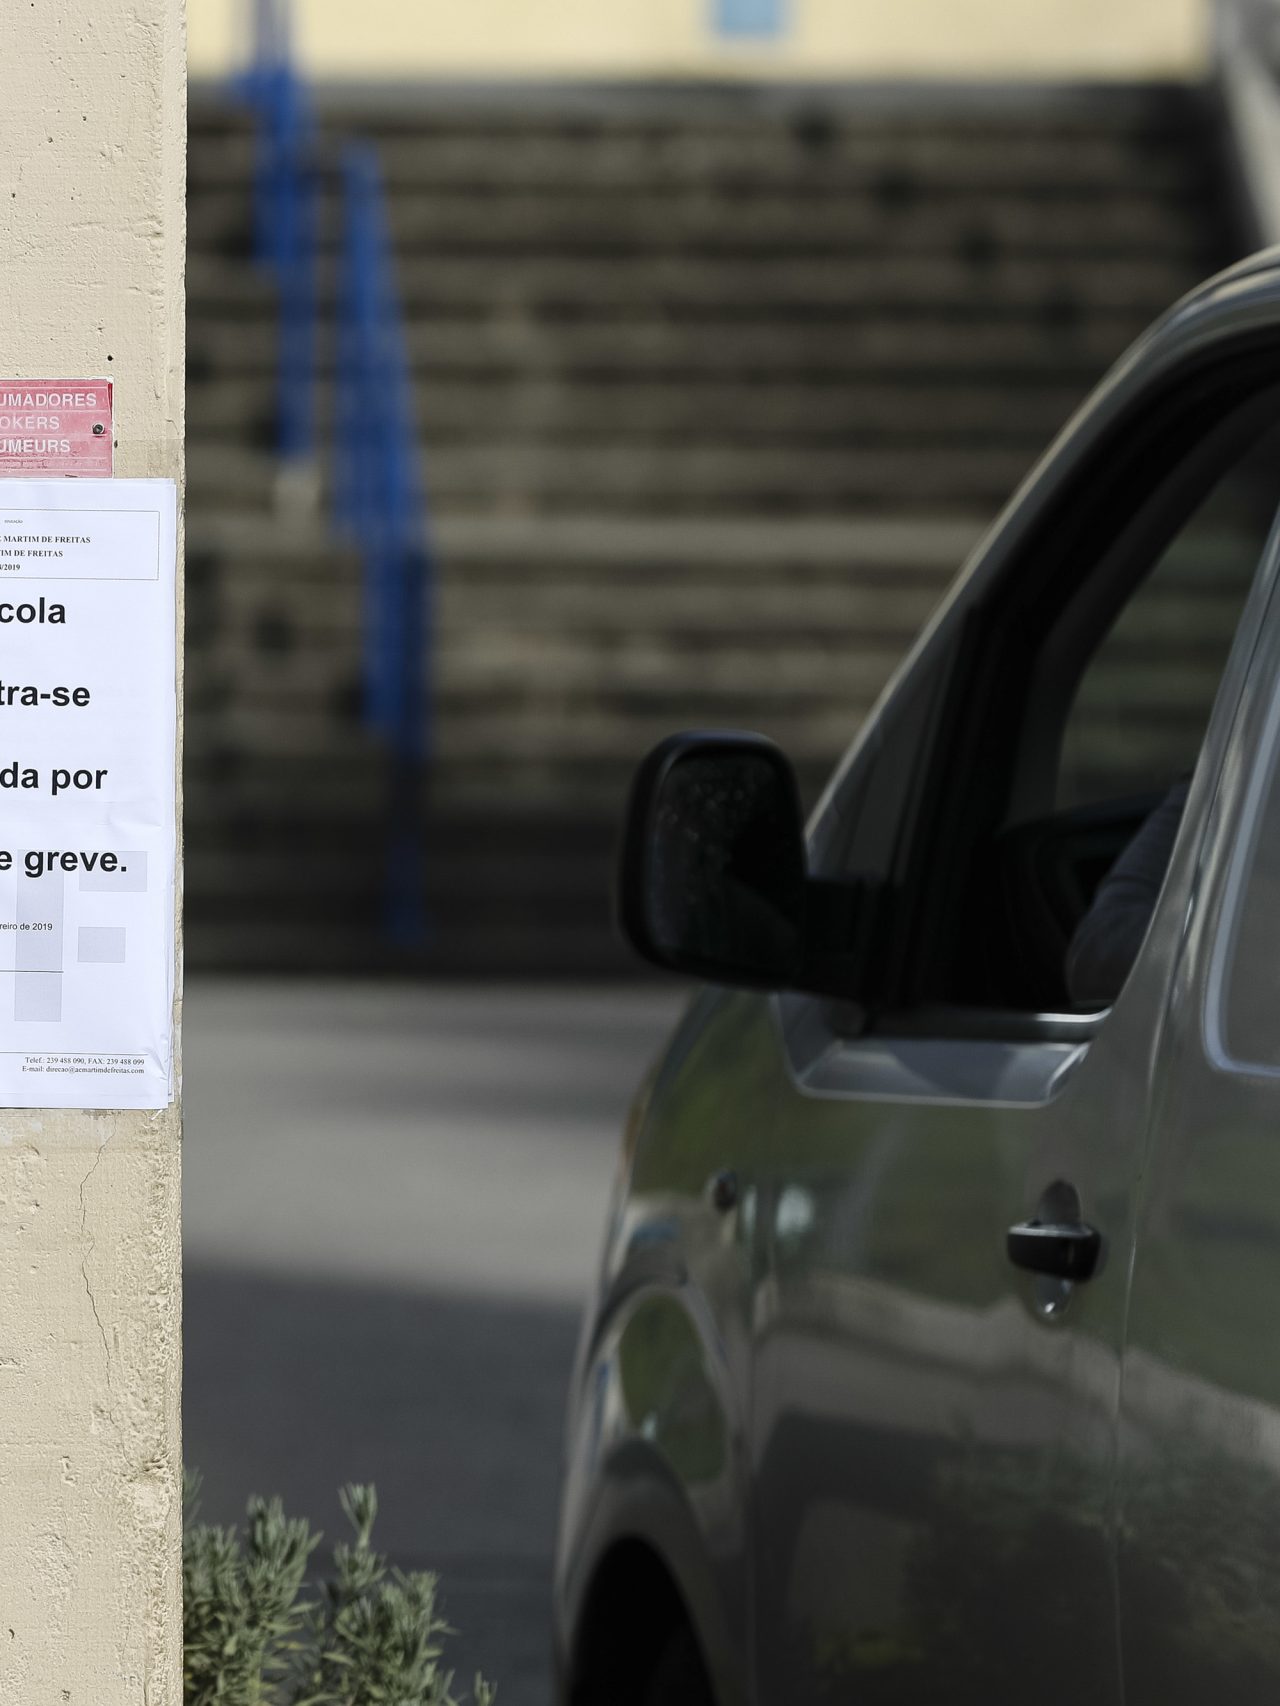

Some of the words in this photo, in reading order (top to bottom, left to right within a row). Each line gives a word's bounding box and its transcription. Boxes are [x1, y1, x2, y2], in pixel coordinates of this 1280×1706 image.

[4, 535, 39, 543] MARTIM
[14, 549, 26, 557] DE
[27, 550, 63, 558] FREITAS
[51, 767, 108, 796] por
[24, 850, 128, 878] greve.
